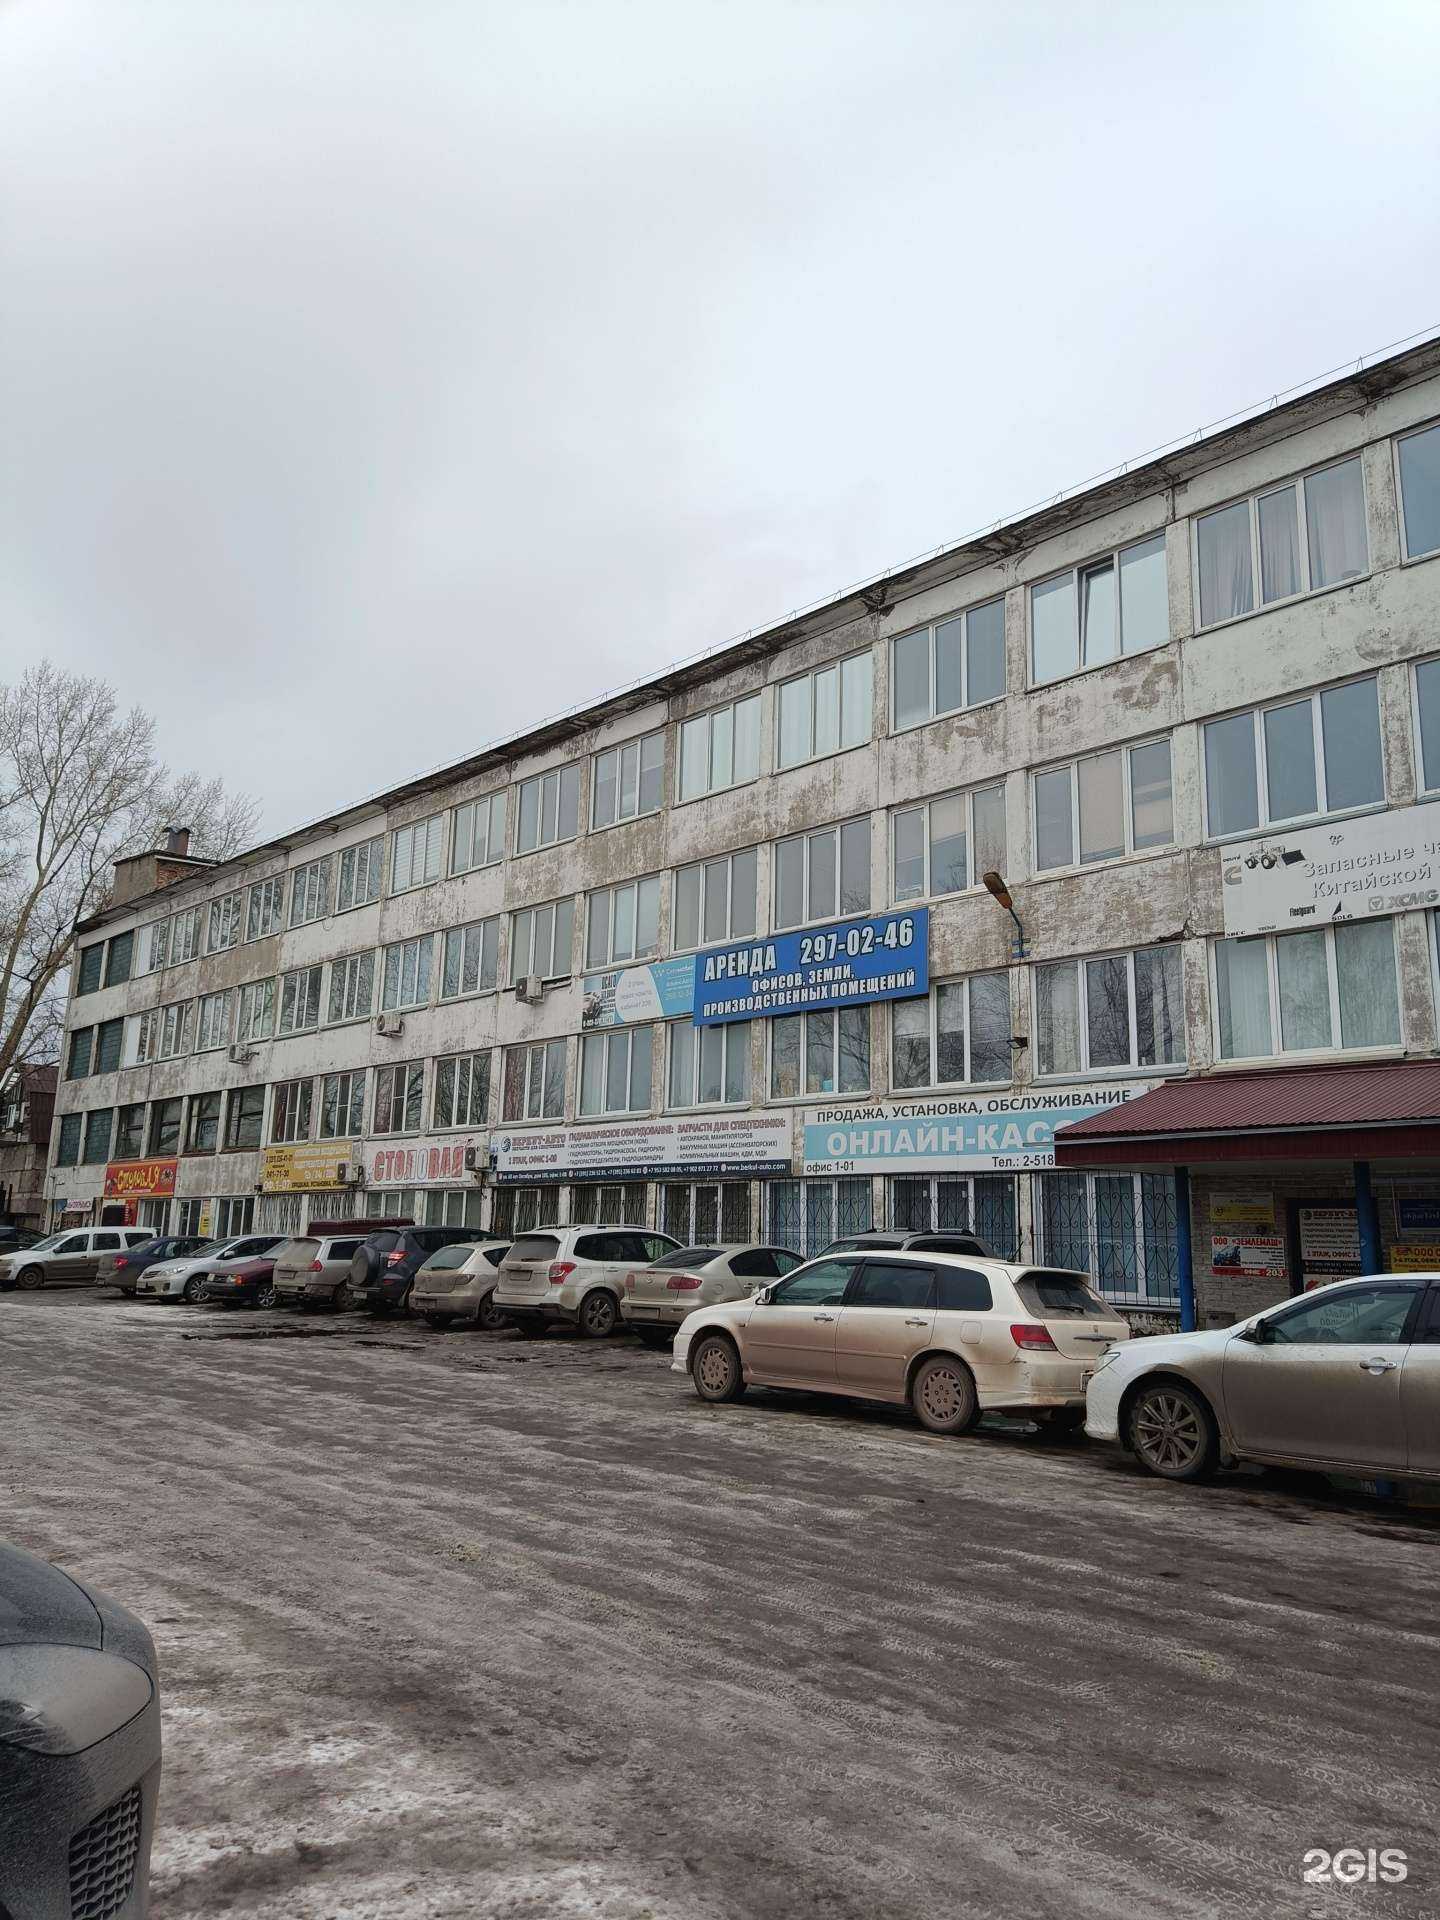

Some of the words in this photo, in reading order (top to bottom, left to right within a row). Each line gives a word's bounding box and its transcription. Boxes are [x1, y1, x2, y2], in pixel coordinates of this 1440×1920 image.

[1303, 847, 1415, 877] Запасные
[1312, 862, 1431, 898] Китайской
[704, 945, 776, 982] АРЕНДА
[800, 918, 913, 965] 297-02-46
[703, 989, 829, 1017] ПРОИЗВОДСТВЕННЫХ
[831, 969, 915, 998] ПОМЕЩЕНИЙ
[752, 973, 806, 993] ОФИСОВ,
[808, 965, 855, 984] ЗЕМЛИ,
[817, 1108, 888, 1122] ПРОДАЖА,
[892, 1101, 983, 1118] УСТАНОВКА,
[988, 1090, 1131, 1111] ОБСЛУЖИВАНИЕ
[806, 1162, 832, 1174] офис
[835, 1161, 854, 1171] 1-01
[992, 1156, 1019, 1167] Тел.:
